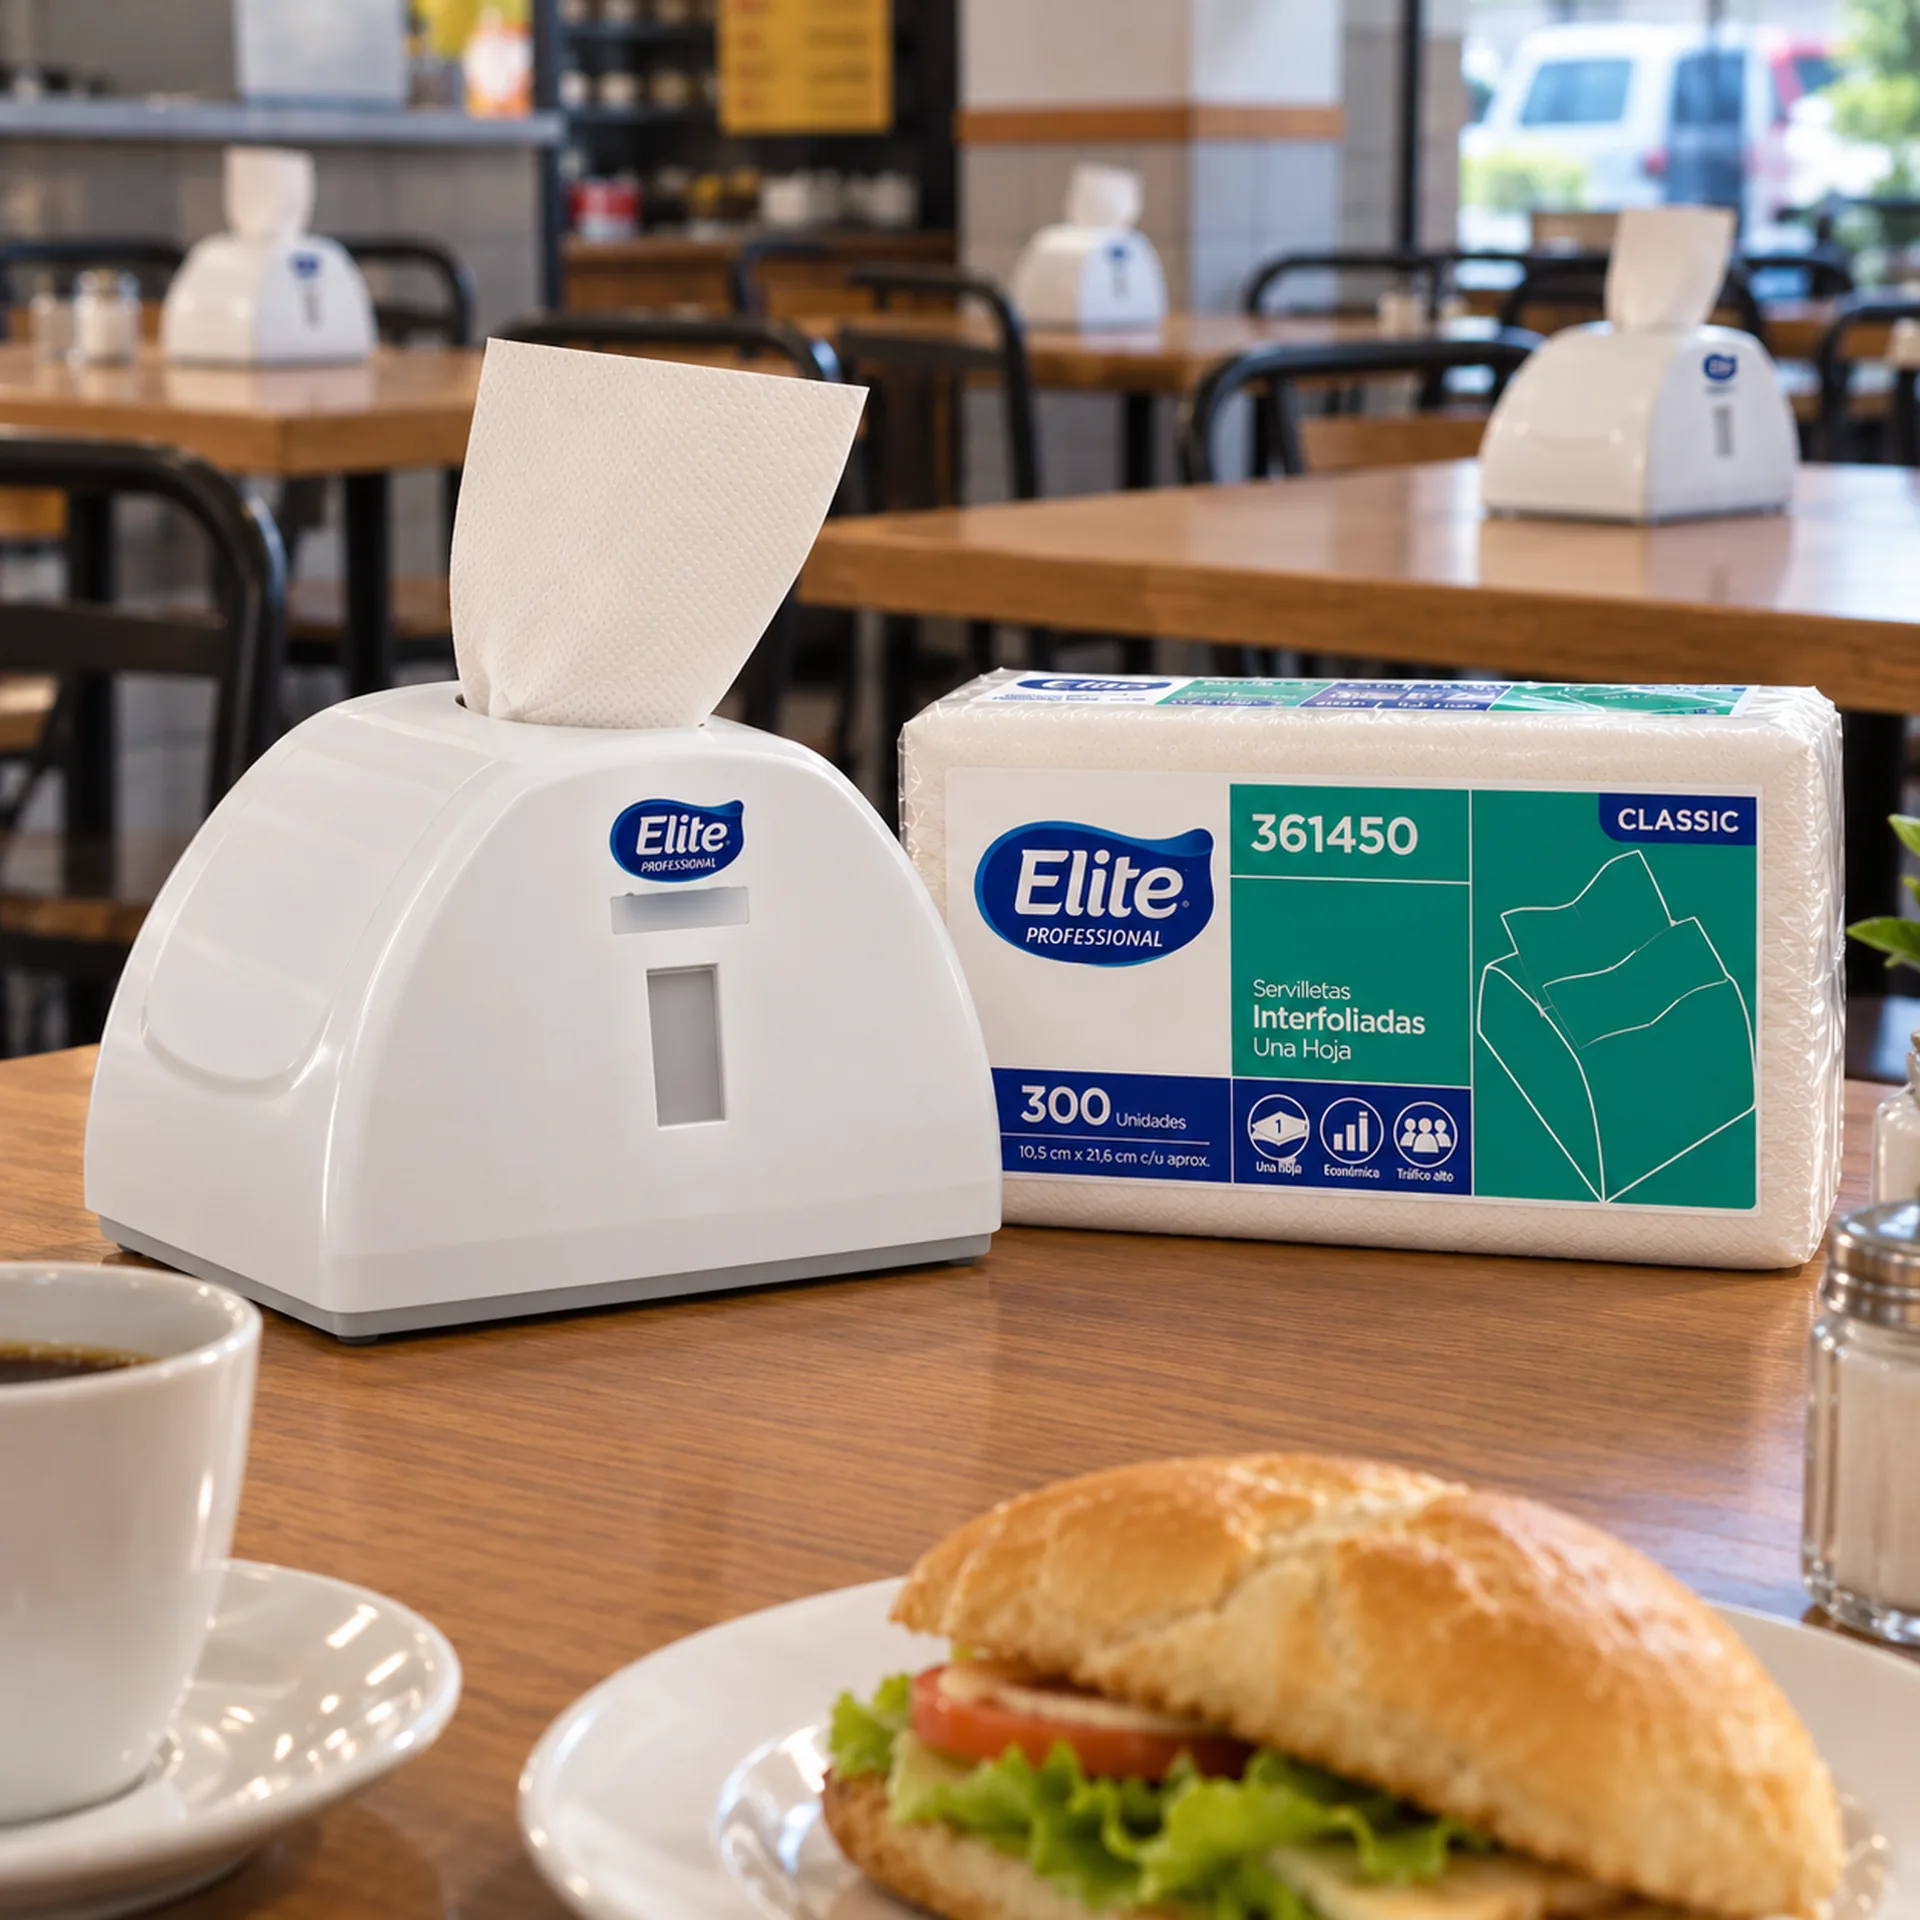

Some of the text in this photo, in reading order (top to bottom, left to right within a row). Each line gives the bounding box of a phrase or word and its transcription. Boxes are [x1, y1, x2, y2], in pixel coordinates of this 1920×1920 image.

[1618, 808, 1740, 834] CLASSIC
[636, 815, 728, 855] Elite
[1251, 813, 1419, 856] 361450
[641, 858, 716, 872] PROFESSIONAL
[1014, 849, 1184, 919] Elite
[1026, 927, 1163, 948] PROFESSIONAL
[1253, 979, 1351, 1000] Servilletas
[1253, 1004, 1426, 1035] Interfoliadas
[1253, 1037, 1352, 1064] Una Hoja
[1020, 1085, 1187, 1130] 300 Unidades
[1275, 1119, 1282, 1134] 1
[1019, 1145, 1210, 1168] 10,5 cm x 21,6 cm c/u aprox.
[1256, 1161, 1276, 1173] Una
